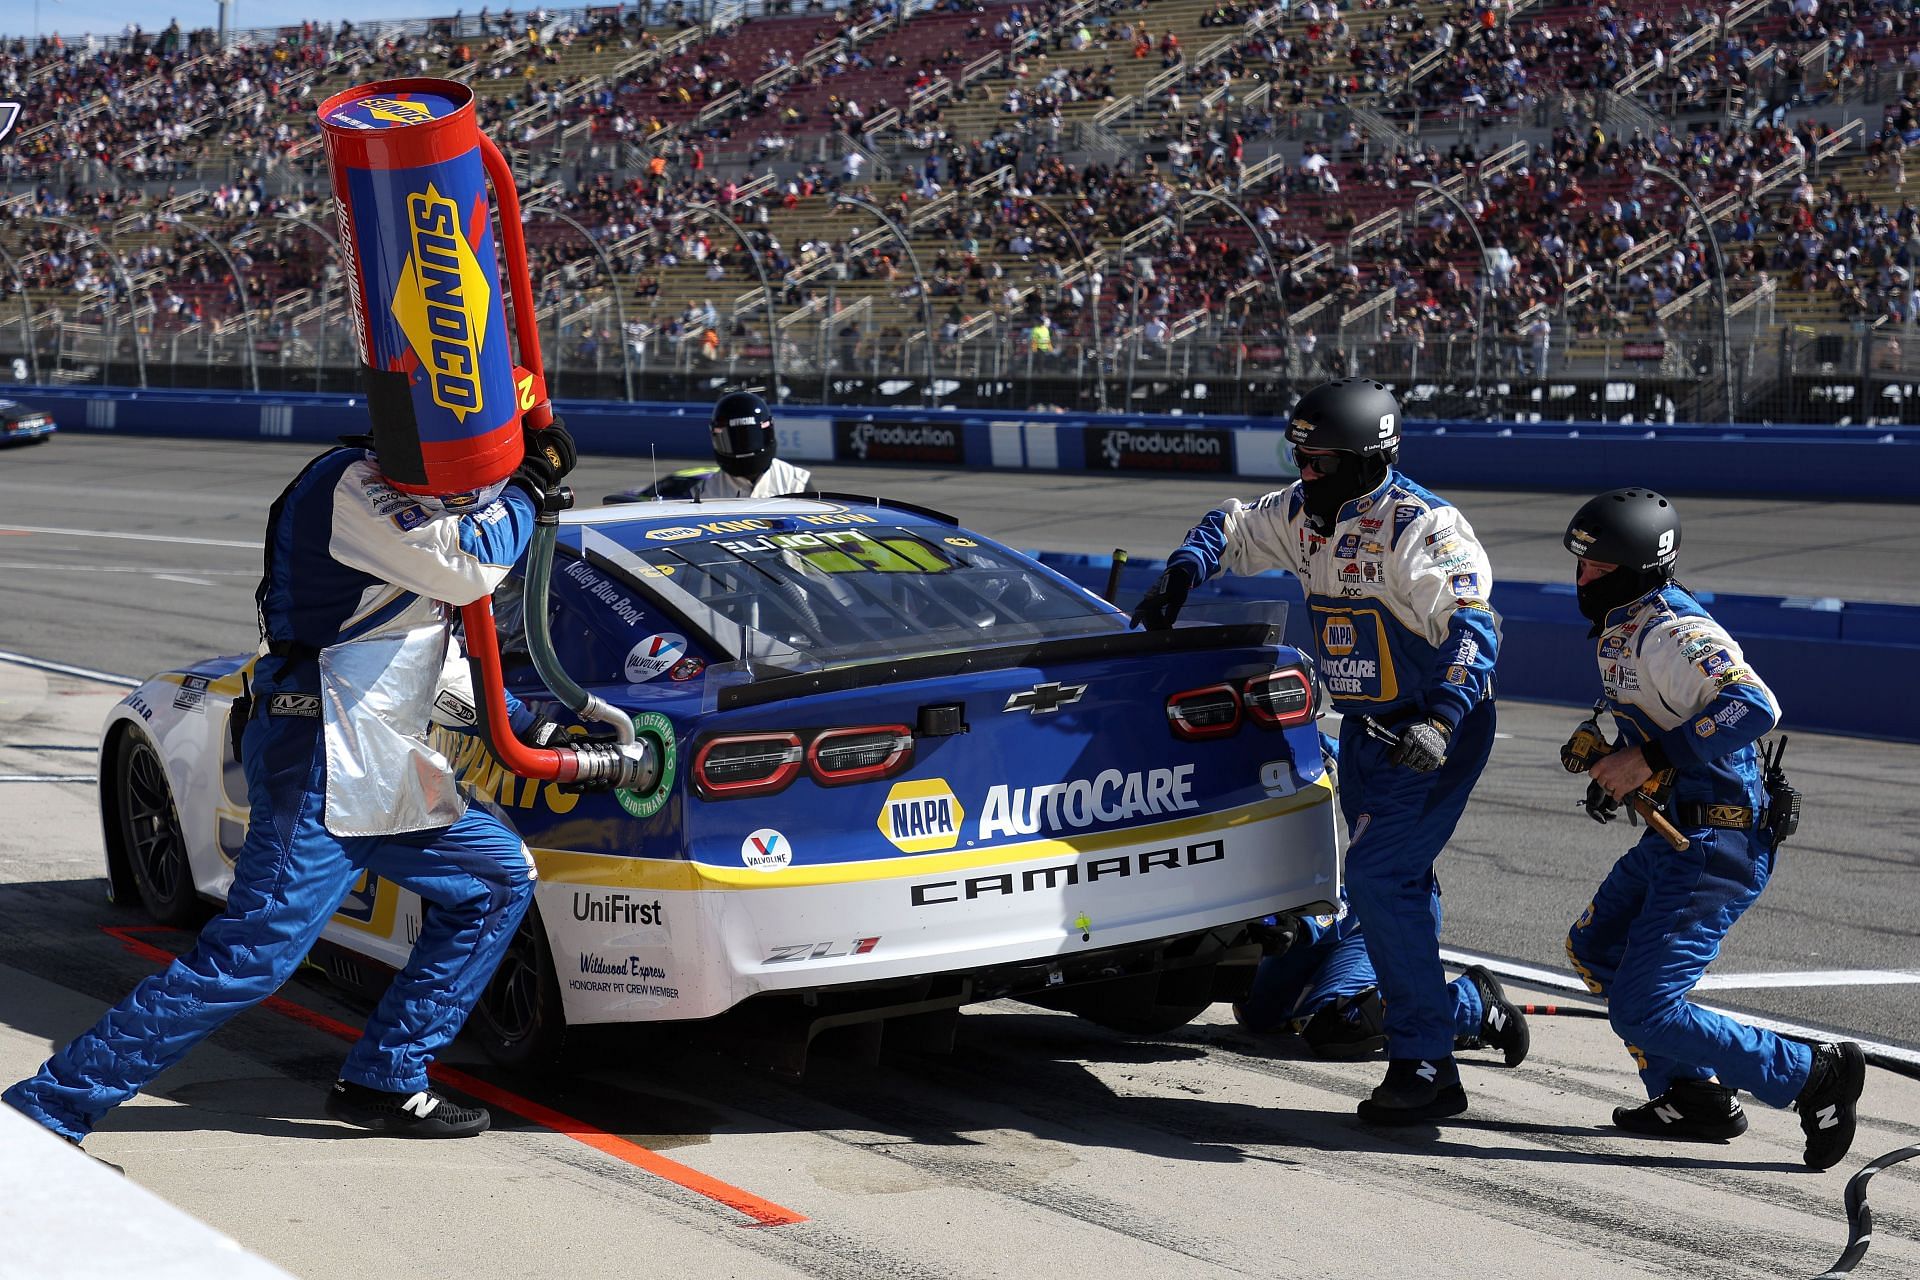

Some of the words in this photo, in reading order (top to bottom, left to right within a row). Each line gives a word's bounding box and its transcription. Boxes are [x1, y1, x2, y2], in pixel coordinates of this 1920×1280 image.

[416, 197, 478, 408] SUNOCO
[12, 357, 29, 380] 3
[518, 375, 536, 411] 2
[729, 416, 757, 427] OFFICIAL
[1378, 413, 1395, 439] 9
[862, 423, 955, 447] Production
[1115, 430, 1221, 455] Production
[655, 527, 695, 540] NAPA
[697, 518, 775, 534] KNO
[796, 512, 879, 526] HOW
[724, 529, 871, 555] ELLIOTT
[1656, 528, 1675, 557] 9
[563, 560, 600, 590] Kelley
[590, 580, 619, 605] Blue
[611, 597, 645, 627] Book
[1327, 624, 1353, 646] NAPA
[626, 653, 670, 673] VALVOLINE
[1320, 657, 1376, 679] AUTOCARE
[1328, 678, 1362, 694] CENTER
[1725, 705, 1750, 728] CENTER
[634, 713, 674, 753] BIOETHANOL
[1258, 759, 1298, 798] 9
[624, 783, 671, 815] BIOETHANOL
[890, 797, 954, 839] NAPA
[978, 763, 1200, 840] AUTOCARE
[747, 853, 787, 867] VALVOLINE
[910, 839, 1225, 907] CAMARO
[572, 892, 662, 926] UniFirst
[761, 936, 882, 966] ZL1
[580, 951, 629, 978] Wildwood
[629, 955, 666, 979] Express
[569, 979, 612, 993] HONORARY
[613, 981, 625, 993] PIT
[625, 982, 649, 996] CREW
[649, 986, 680, 999] MEMBER
[1488, 1004, 1507, 1032] N
[1415, 1060, 1437, 1083] N
[401, 1091, 440, 1119] N
[1654, 1103, 1685, 1124] N
[1816, 1103, 1839, 1130] N
